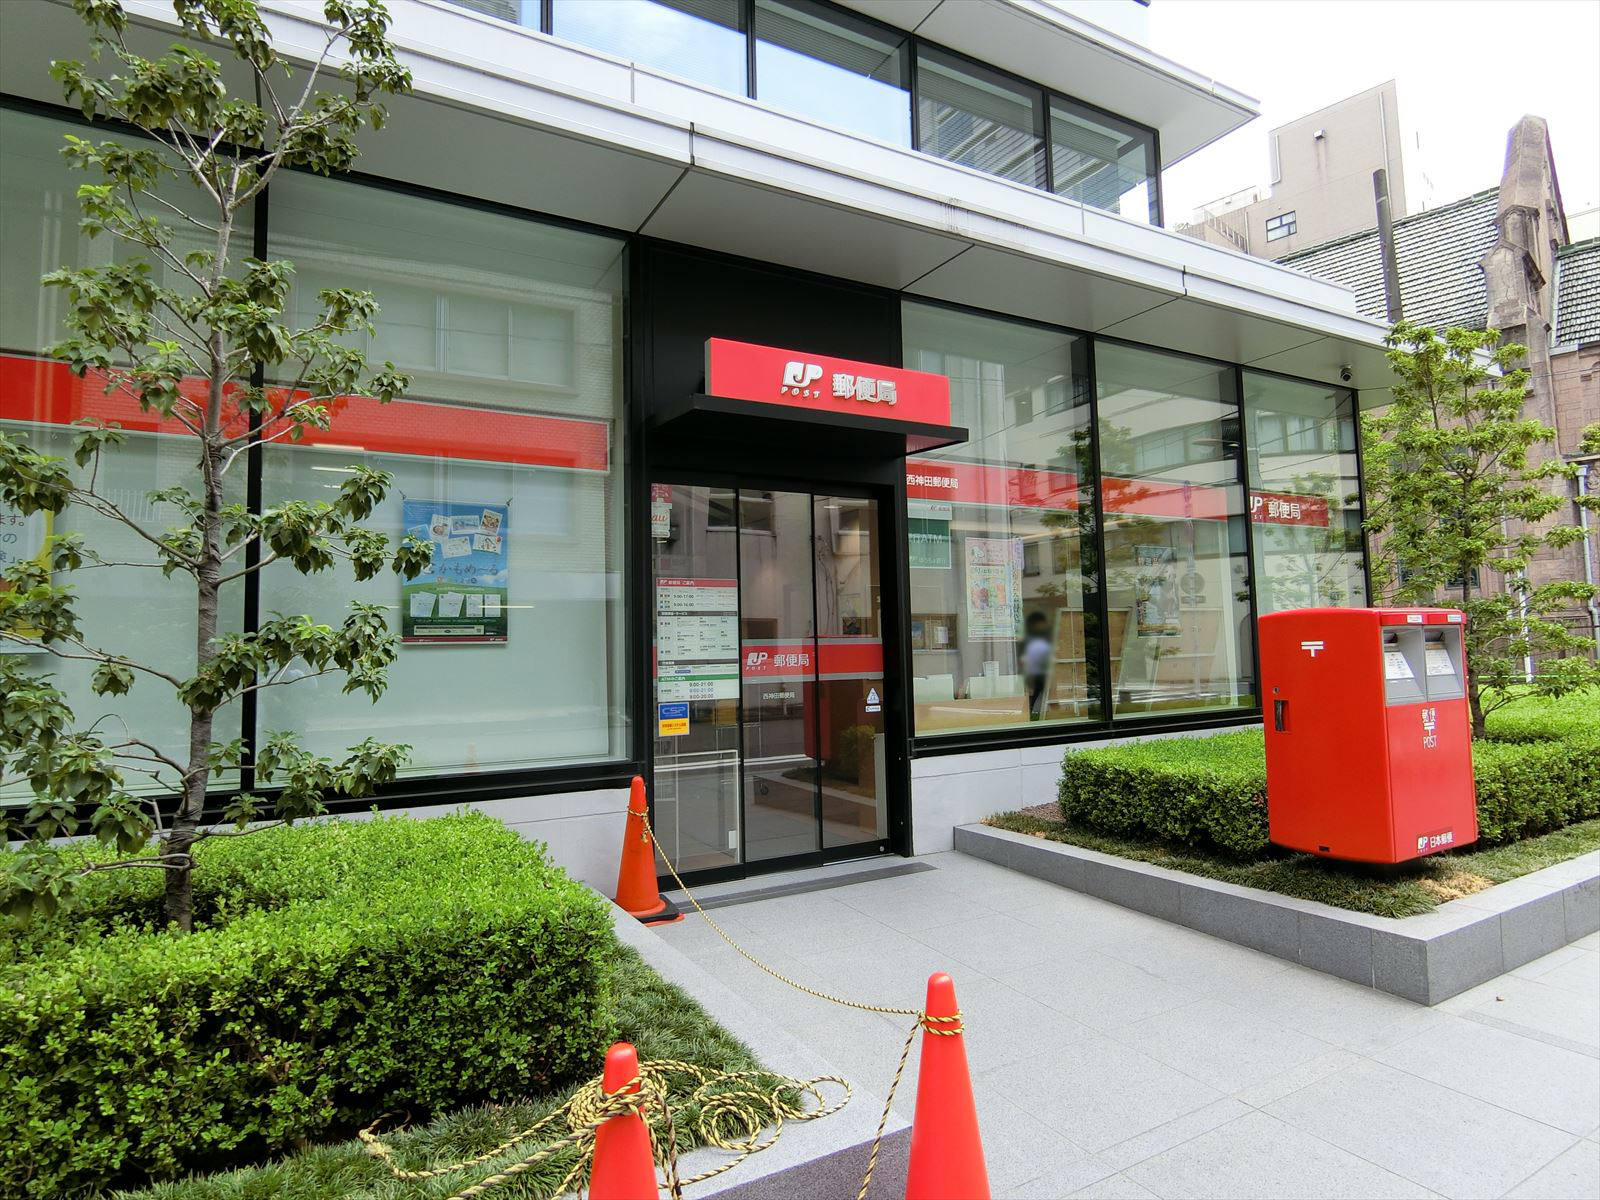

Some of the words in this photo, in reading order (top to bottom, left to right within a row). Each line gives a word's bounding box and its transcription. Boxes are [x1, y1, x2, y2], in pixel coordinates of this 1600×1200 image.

[781, 386, 821, 399] POST
[832, 373, 897, 405] 郵便局
[906, 474, 959, 489] 西神田郵便局
[1268, 501, 1301, 520] 郵便局
[774, 653, 809, 667] 郵便局
[762, 691, 796, 700] 西神田郵便局
[662, 706, 686, 715] CSP
[1421, 707, 1436, 723] 郵便
[1423, 735, 1437, 749] POST
[1429, 831, 1453, 848] 日本郵便
